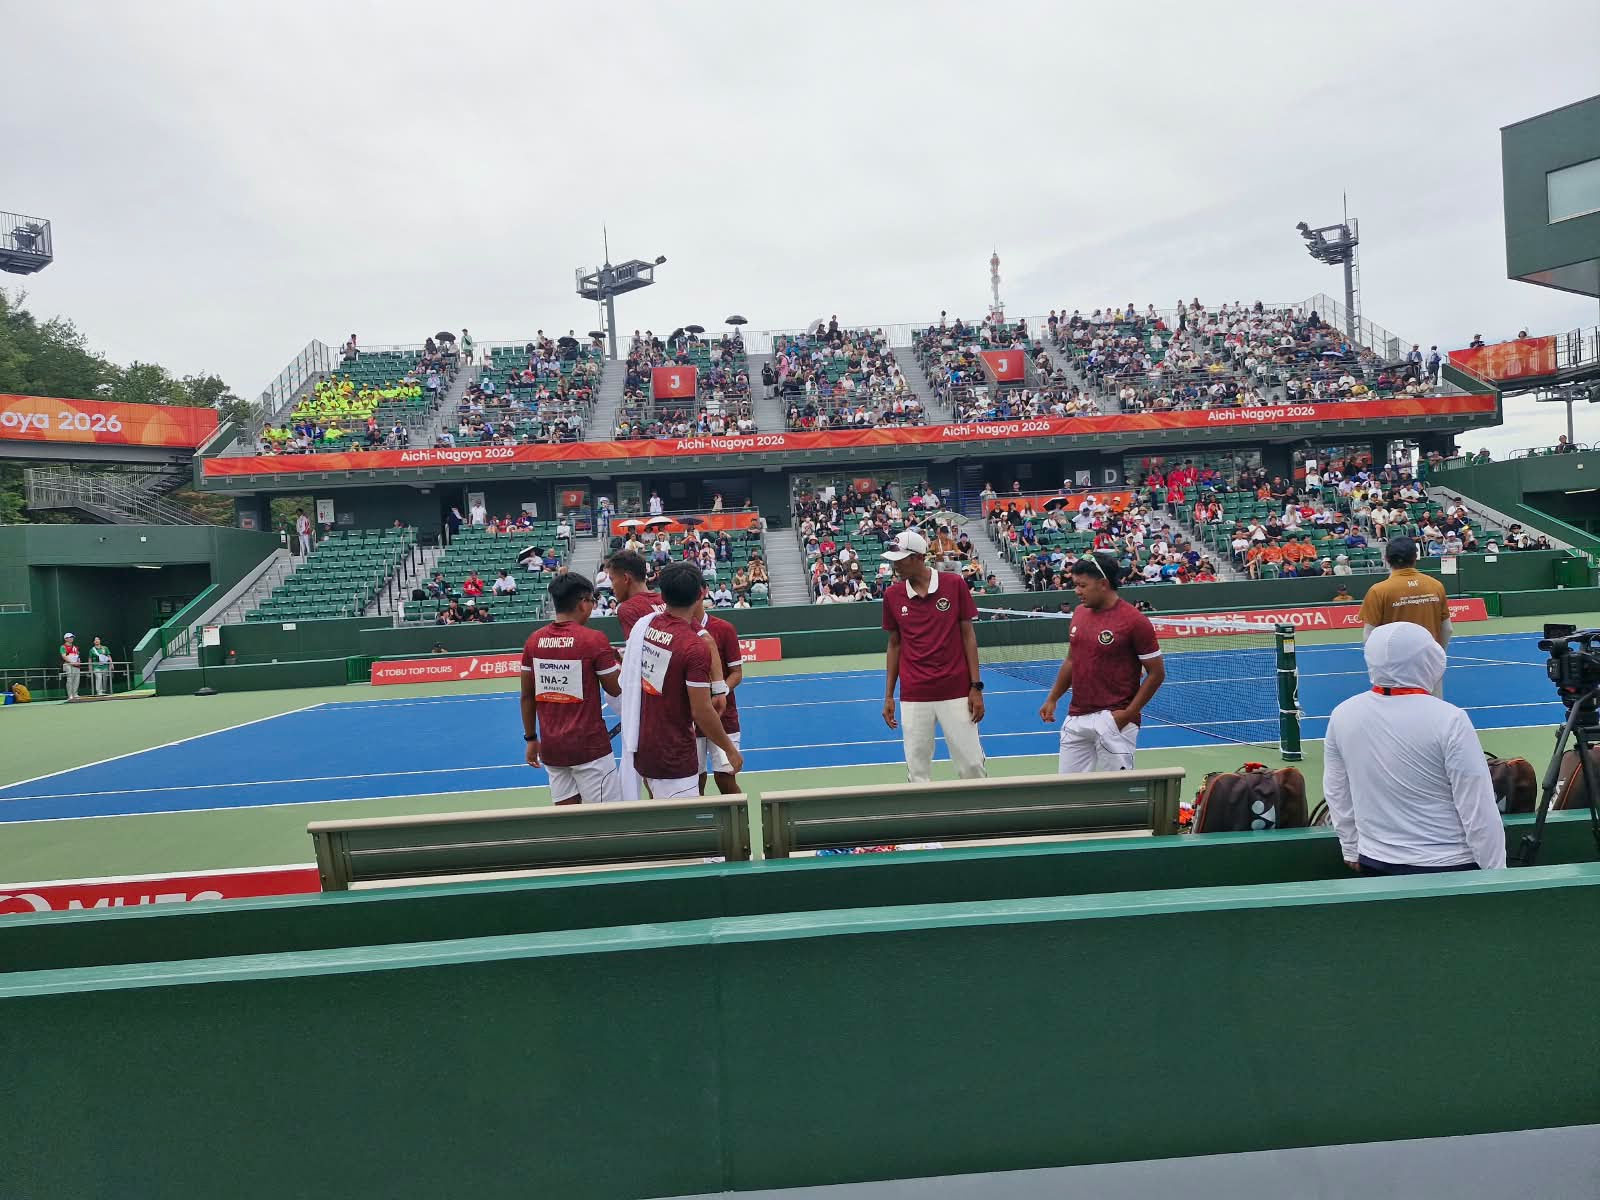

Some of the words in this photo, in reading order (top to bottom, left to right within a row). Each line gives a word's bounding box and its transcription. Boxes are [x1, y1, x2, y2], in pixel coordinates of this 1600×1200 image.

[998, 358, 1008, 373] J
[670, 375, 680, 389] J
[1207, 408, 1284, 421] Aichi-Nagoya
[1287, 406, 1315, 417] 2026
[58, 411, 122, 433] 2026
[942, 424, 1019, 436] Aichi-Nagoya
[1022, 421, 1050, 432] 2026
[677, 437, 754, 451] Aichi-Nagoya
[757, 435, 785, 446] 2026
[401, 449, 482, 462] Aichi-Nagoya
[485, 447, 514, 458] 2026
[1105, 469, 1118, 483] D
[1254, 612, 1327, 628] TOYOTA
[537, 636, 574, 648] INDONESIA
[384, 668, 407, 677] TOBU
[408, 667, 425, 676] TOP
[426, 665, 453, 675] TOURS
[539, 662, 570, 670] BORNAN
[540, 675, 568, 685] INA-2
